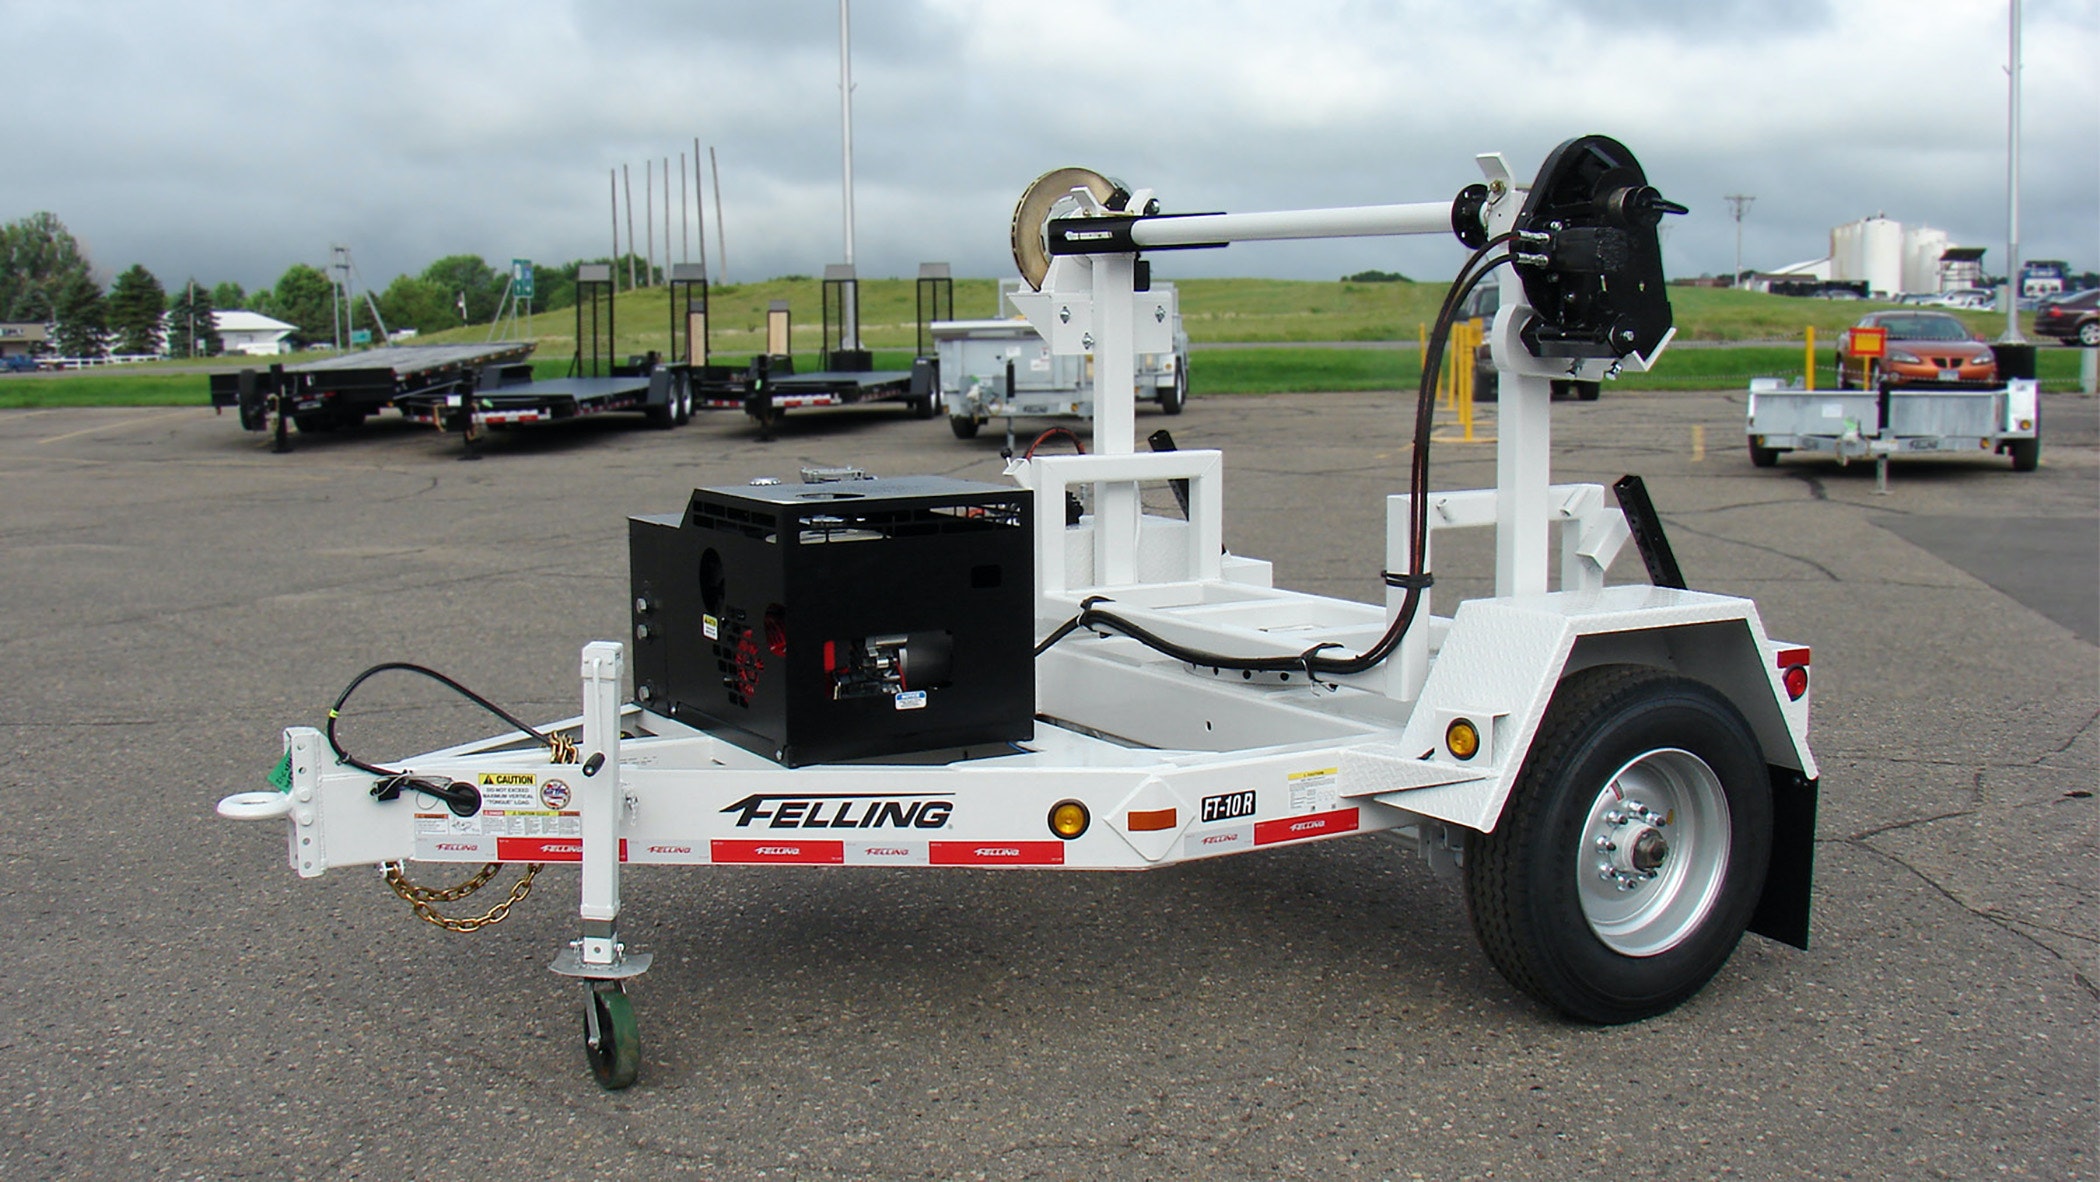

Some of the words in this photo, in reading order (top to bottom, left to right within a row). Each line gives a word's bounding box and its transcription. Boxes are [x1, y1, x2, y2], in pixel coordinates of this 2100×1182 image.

[496, 775, 533, 785] CAUTION
[719, 792, 955, 829] FELLING
[1289, 820, 1326, 832] FELLING
[1201, 833, 1238, 845] FELLING
[435, 843, 478, 851] FELLING
[647, 845, 692, 854] FELLING
[754, 846, 800, 855] FELLING
[864, 847, 909, 856] FELLING
[973, 848, 1020, 857] FELLING
